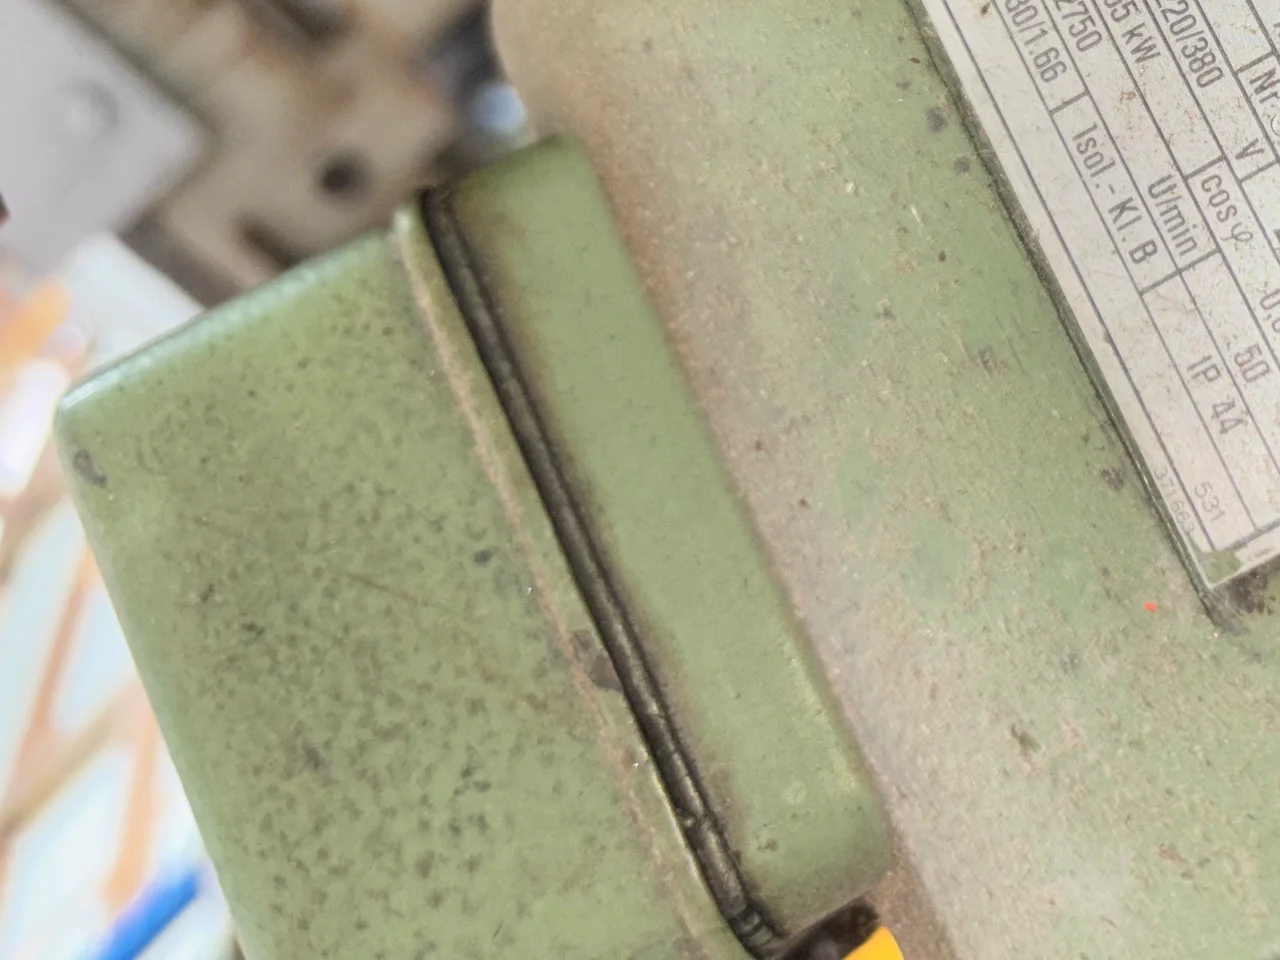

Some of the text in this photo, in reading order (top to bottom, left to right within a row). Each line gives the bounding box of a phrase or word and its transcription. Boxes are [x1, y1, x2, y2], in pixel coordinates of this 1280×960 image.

[1120, 21, 1162, 65] kW
[1233, 136, 1267, 162] V
[1146, 173, 1199, 258] U/min
[1127, 238, 1159, 265] B
[1232, 342, 1272, 384] 50
[1185, 353, 1250, 436] IP 44
[1192, 480, 1227, 524] 531
